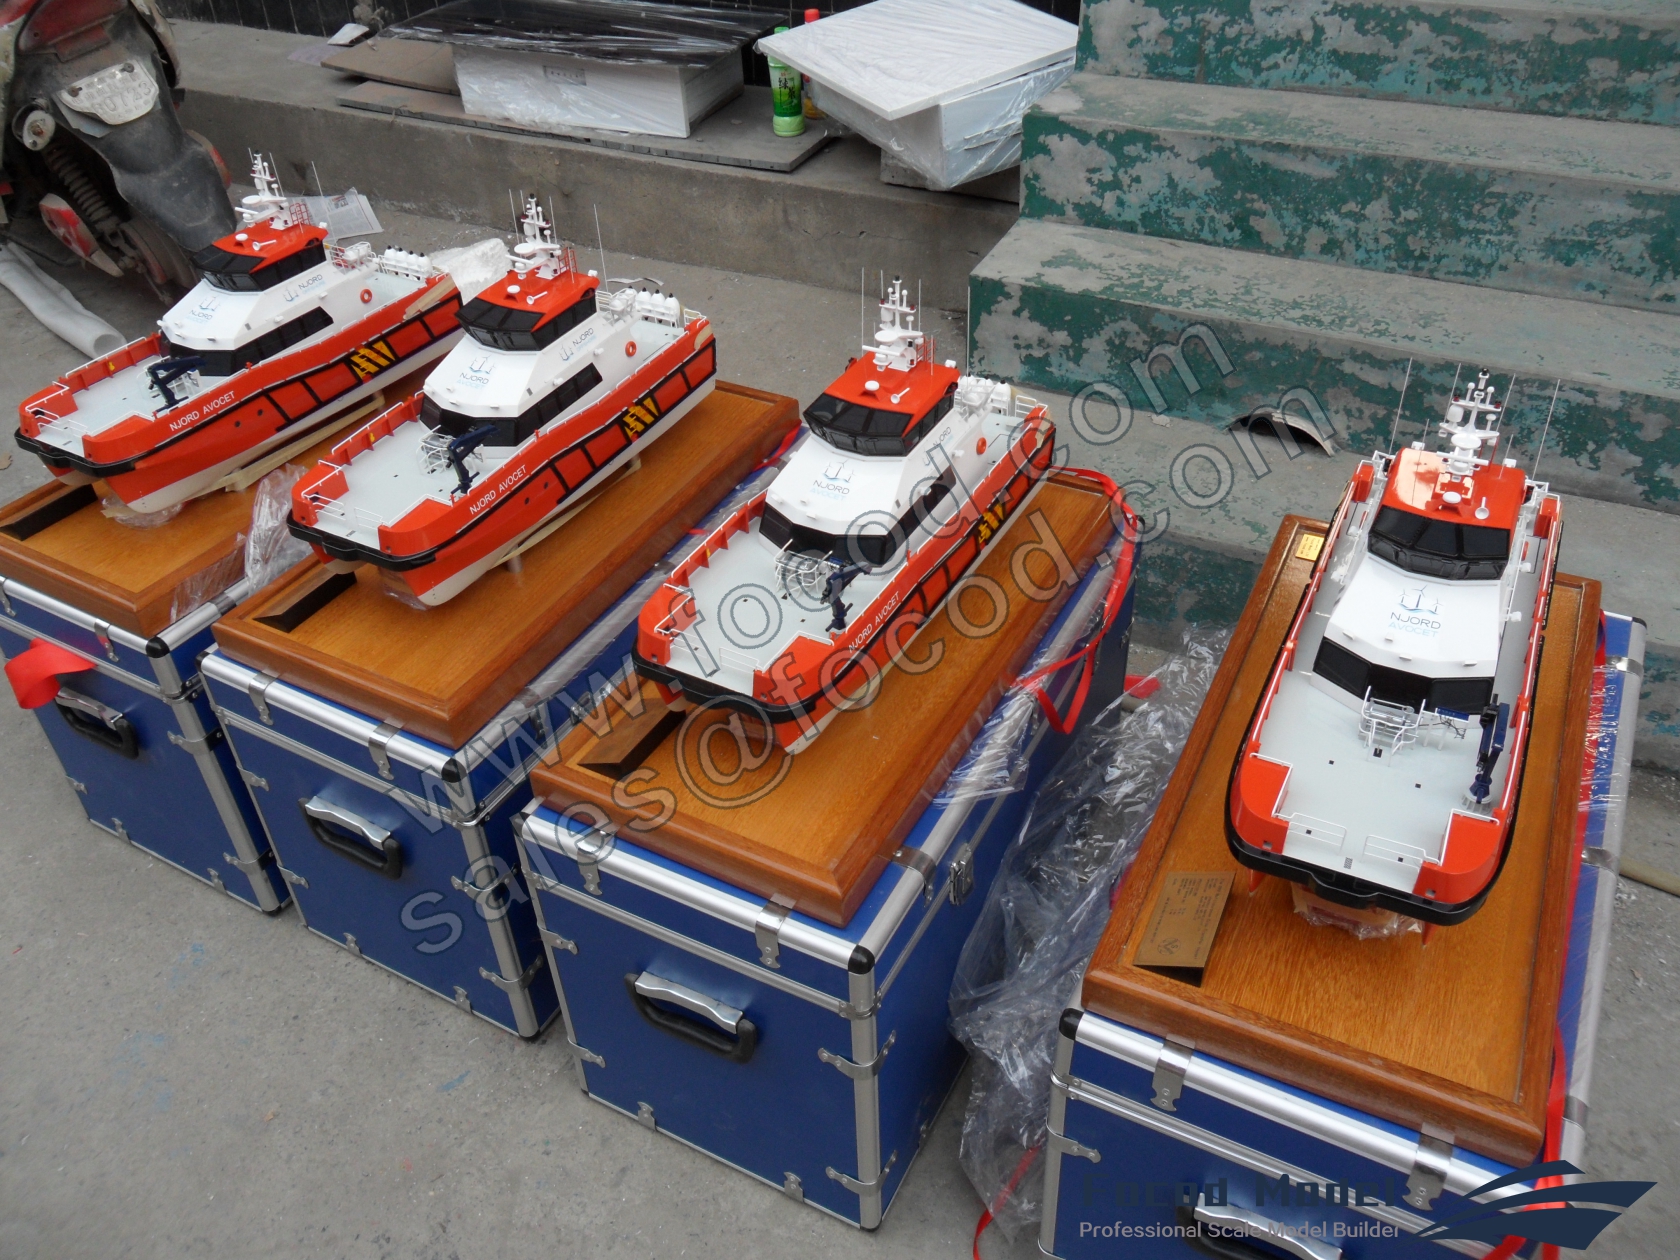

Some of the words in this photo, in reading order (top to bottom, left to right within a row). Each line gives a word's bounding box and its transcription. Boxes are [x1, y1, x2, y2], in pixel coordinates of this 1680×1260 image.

[298, 273, 323, 290] NJORD
[572, 327, 594, 346] NJORD
[460, 372, 489, 385] NJORD
[169, 410, 200, 431] NJORD
[202, 390, 235, 415] AVOCET
[469, 490, 496, 515] NJORD
[498, 464, 527, 493] AVOCET
[810, 487, 847, 501] AVOCET
[813, 480, 850, 495] NJORD
[848, 623, 873, 653] NJORD
[875, 591, 899, 625] AVOCET
[1390, 611, 1441, 629] NJORD
[1388, 621, 1439, 637] AVOCET
